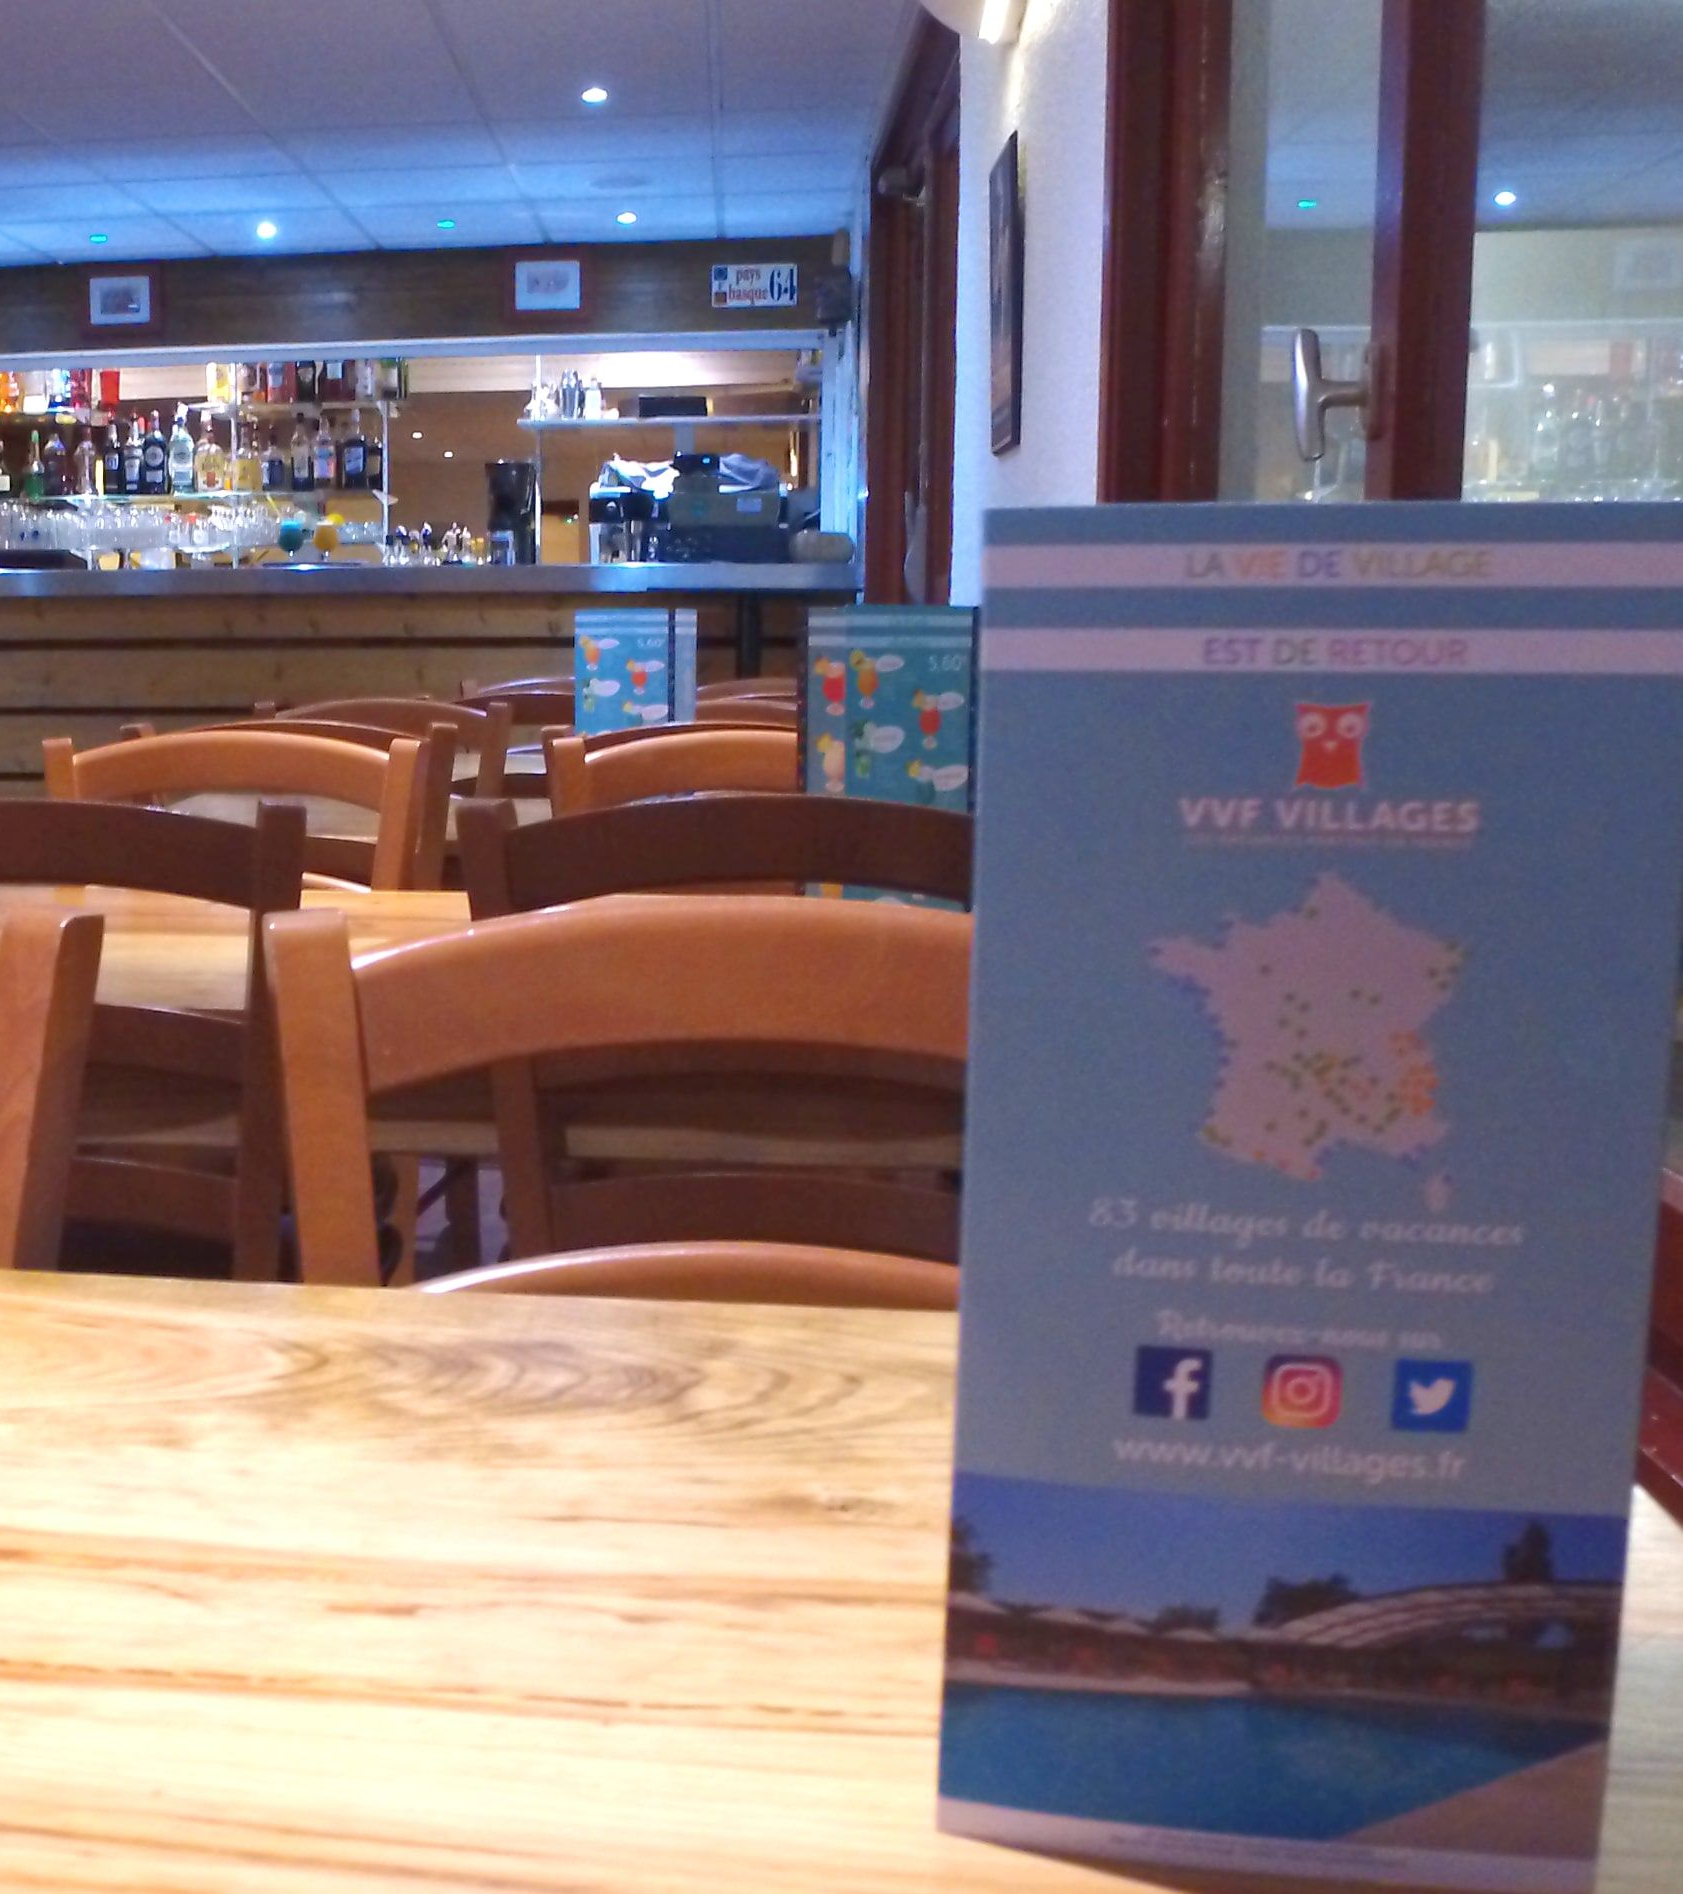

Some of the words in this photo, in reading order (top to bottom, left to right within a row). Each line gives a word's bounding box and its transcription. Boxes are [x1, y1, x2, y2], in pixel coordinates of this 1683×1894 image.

[770, 269, 796, 301] 64
[1185, 549, 1225, 580] LA
[1236, 550, 1285, 580] VIE
[1295, 550, 1342, 580] DE
[1352, 549, 1491, 580] VILLAGE
[1204, 636, 1261, 666] EST
[1271, 637, 1317, 667] DE
[1327, 637, 1468, 667] RETOUR
[1177, 797, 1262, 829] VVF
[1274, 799, 1481, 833] VILLAGES
[1149, 1202, 1290, 1250] villages
[1301, 1209, 1347, 1242] de
[1358, 1219, 1524, 1247] vacances
[1112, 1245, 1198, 1281] dans
[1210, 1255, 1303, 1288] toute
[1314, 1257, 1355, 1289] la
[1366, 1260, 1496, 1295] France
[1112, 1438, 1469, 1484] www.vvf-villages.fr
